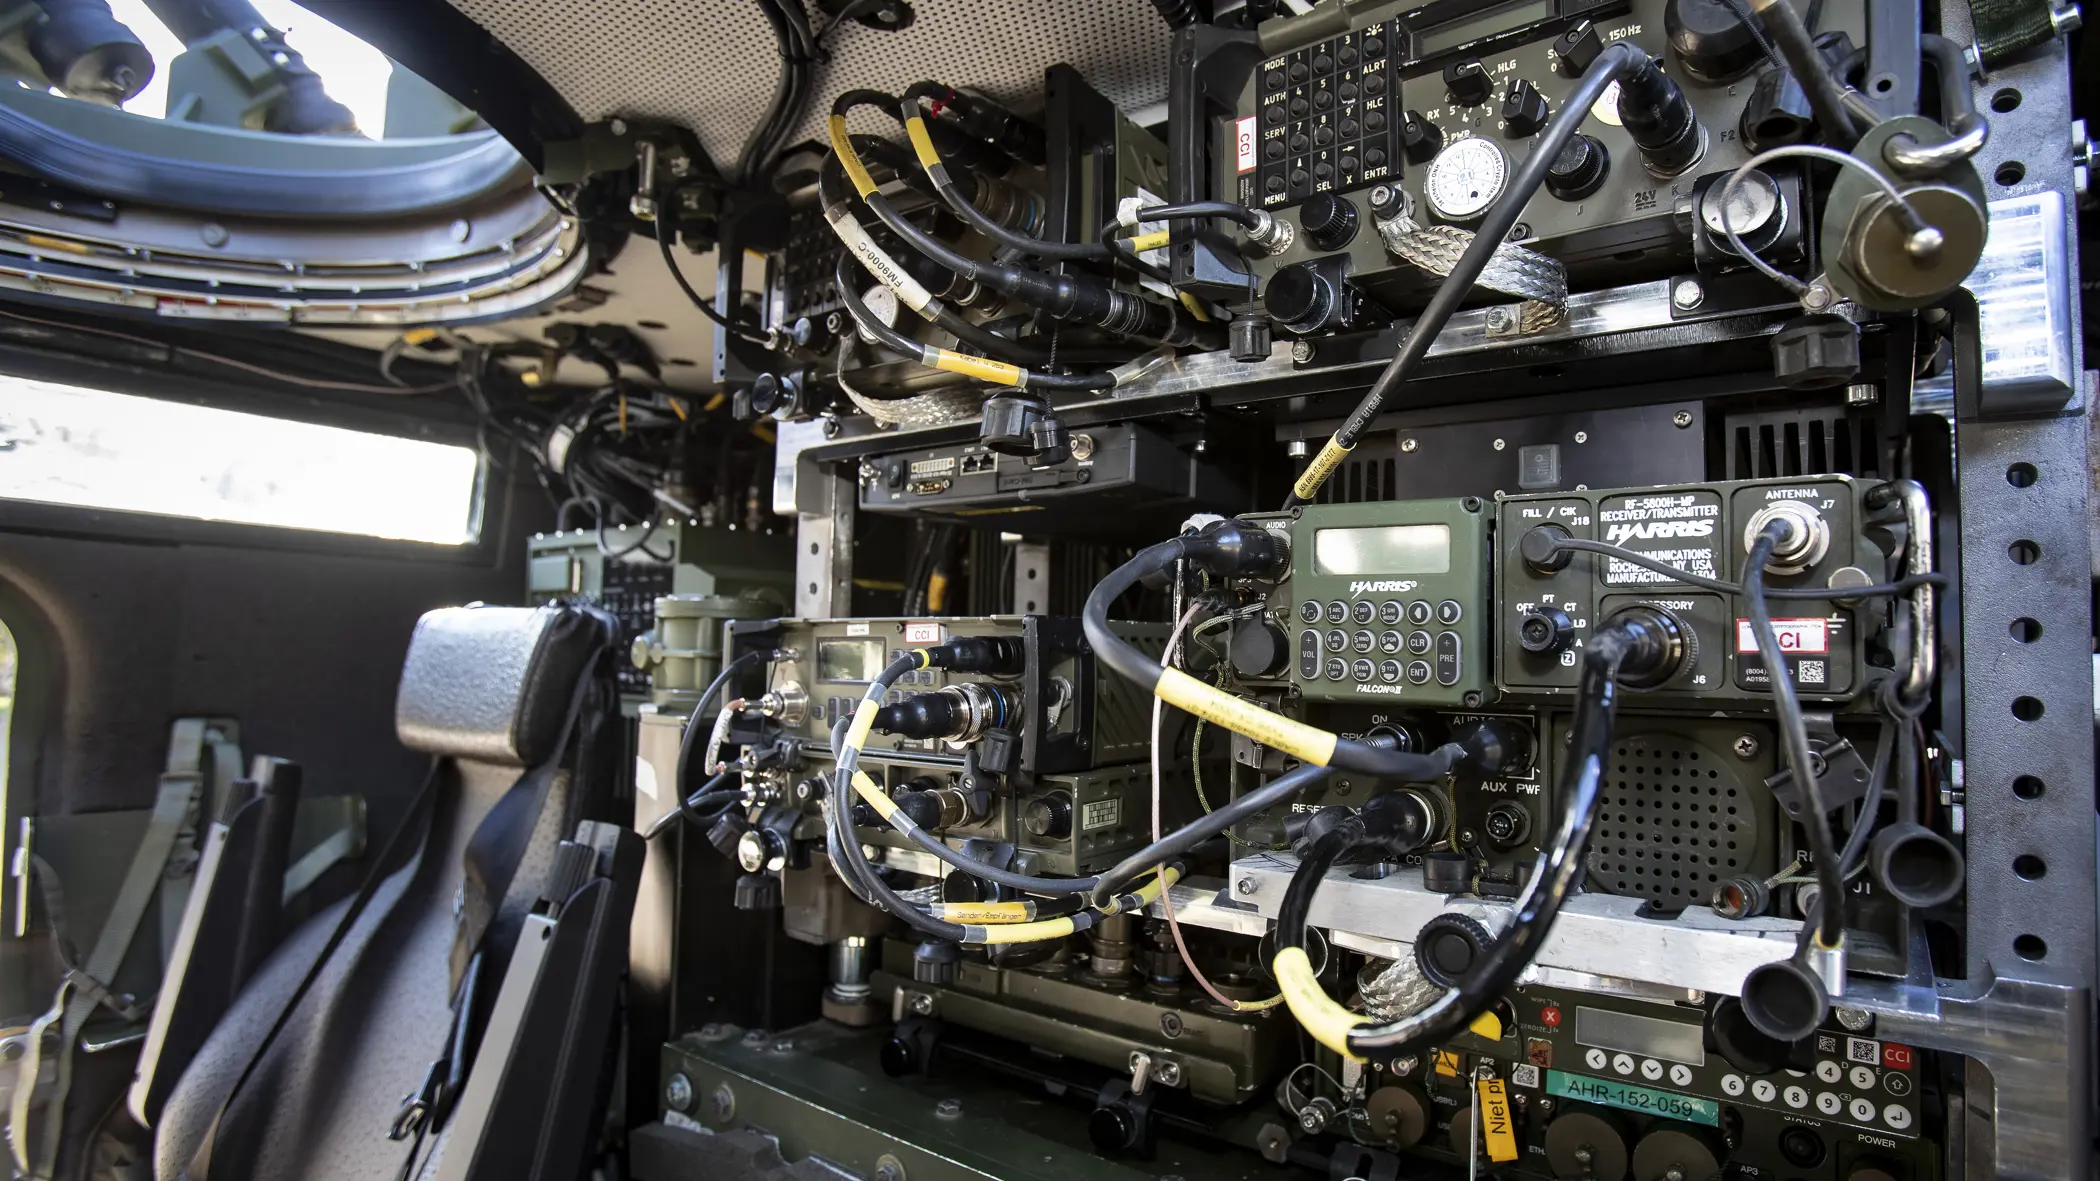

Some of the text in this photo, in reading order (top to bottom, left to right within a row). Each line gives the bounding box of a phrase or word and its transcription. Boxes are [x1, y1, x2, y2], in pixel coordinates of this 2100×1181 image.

[1609, 24, 1642, 41] 150 Hz
[1264, 57, 1286, 71] MODE
[1362, 59, 1387, 75] ALRT
[1497, 60, 1516, 74] HLG
[1345, 71, 1350, 80] 6
[1321, 79, 1326, 88] 5
[1296, 87, 1302, 96] 4
[1499, 92, 1505, 101] 2
[1264, 92, 1287, 106] AUTH
[1366, 97, 1383, 110] HLC
[1427, 109, 1440, 120] RX
[1450, 105, 1455, 115] 5
[1486, 107, 1492, 116] 3
[1462, 113, 1469, 122] 4
[1498, 121, 1504, 130] 0
[1264, 126, 1286, 140] SERV
[1451, 130, 1470, 141] PWR
[1720, 130, 1736, 142] F2
[1240, 133, 1250, 157] CCI
[1480, 142, 1501, 164] Controlled
[1494, 164, 1503, 185] Crypto
[1364, 166, 1388, 180] ENTR
[1346, 175, 1352, 184] X
[1316, 181, 1332, 192] SEL
[1264, 192, 1286, 205] MENU
[857, 241, 903, 288] FM9000-C
[1765, 489, 1819, 500] ANTENNA
[1625, 496, 1695, 510] RF-5800H-MP
[1820, 500, 1835, 509] J7
[1523, 509, 1542, 518] FILL
[1560, 507, 1576, 516] CIK
[1600, 505, 1719, 521] RECEIVER/TRANSMITTER
[1571, 517, 1590, 525] J18
[1606, 519, 1715, 547] HARRIS
[1673, 560, 1713, 570] NY USA
[1543, 595, 1554, 603] PT
[1564, 603, 1577, 611] CT
[1573, 619, 1586, 628] LD
[915, 630, 930, 640] CCI
[1779, 632, 1800, 648] CI
[1410, 639, 1425, 647] CLR
[1575, 639, 1583, 647] A
[1692, 675, 1706, 684] J6
[1356, 684, 1389, 693] FALCON
[1372, 714, 1388, 724] ON
[1481, 781, 1507, 793] AUX
[1480, 1057, 1495, 1066] AP2
[1884, 1049, 1911, 1063] CCI
[1824, 1061, 1848, 1077] 4 D
[1858, 1072, 1866, 1083] 5
[1728, 1080, 1737, 1091] 6
[1760, 1085, 1768, 1096] 7
[1568, 1080, 1693, 1117] AHR-152-059
[1791, 1092, 1800, 1102] 8
[1824, 1098, 1833, 1109] 9
[1858, 1104, 1867, 1115] 0
[1488, 1100, 1507, 1134] Niet
[1857, 1133, 1896, 1149] POWER
[1740, 1165, 1759, 1176] AP3
